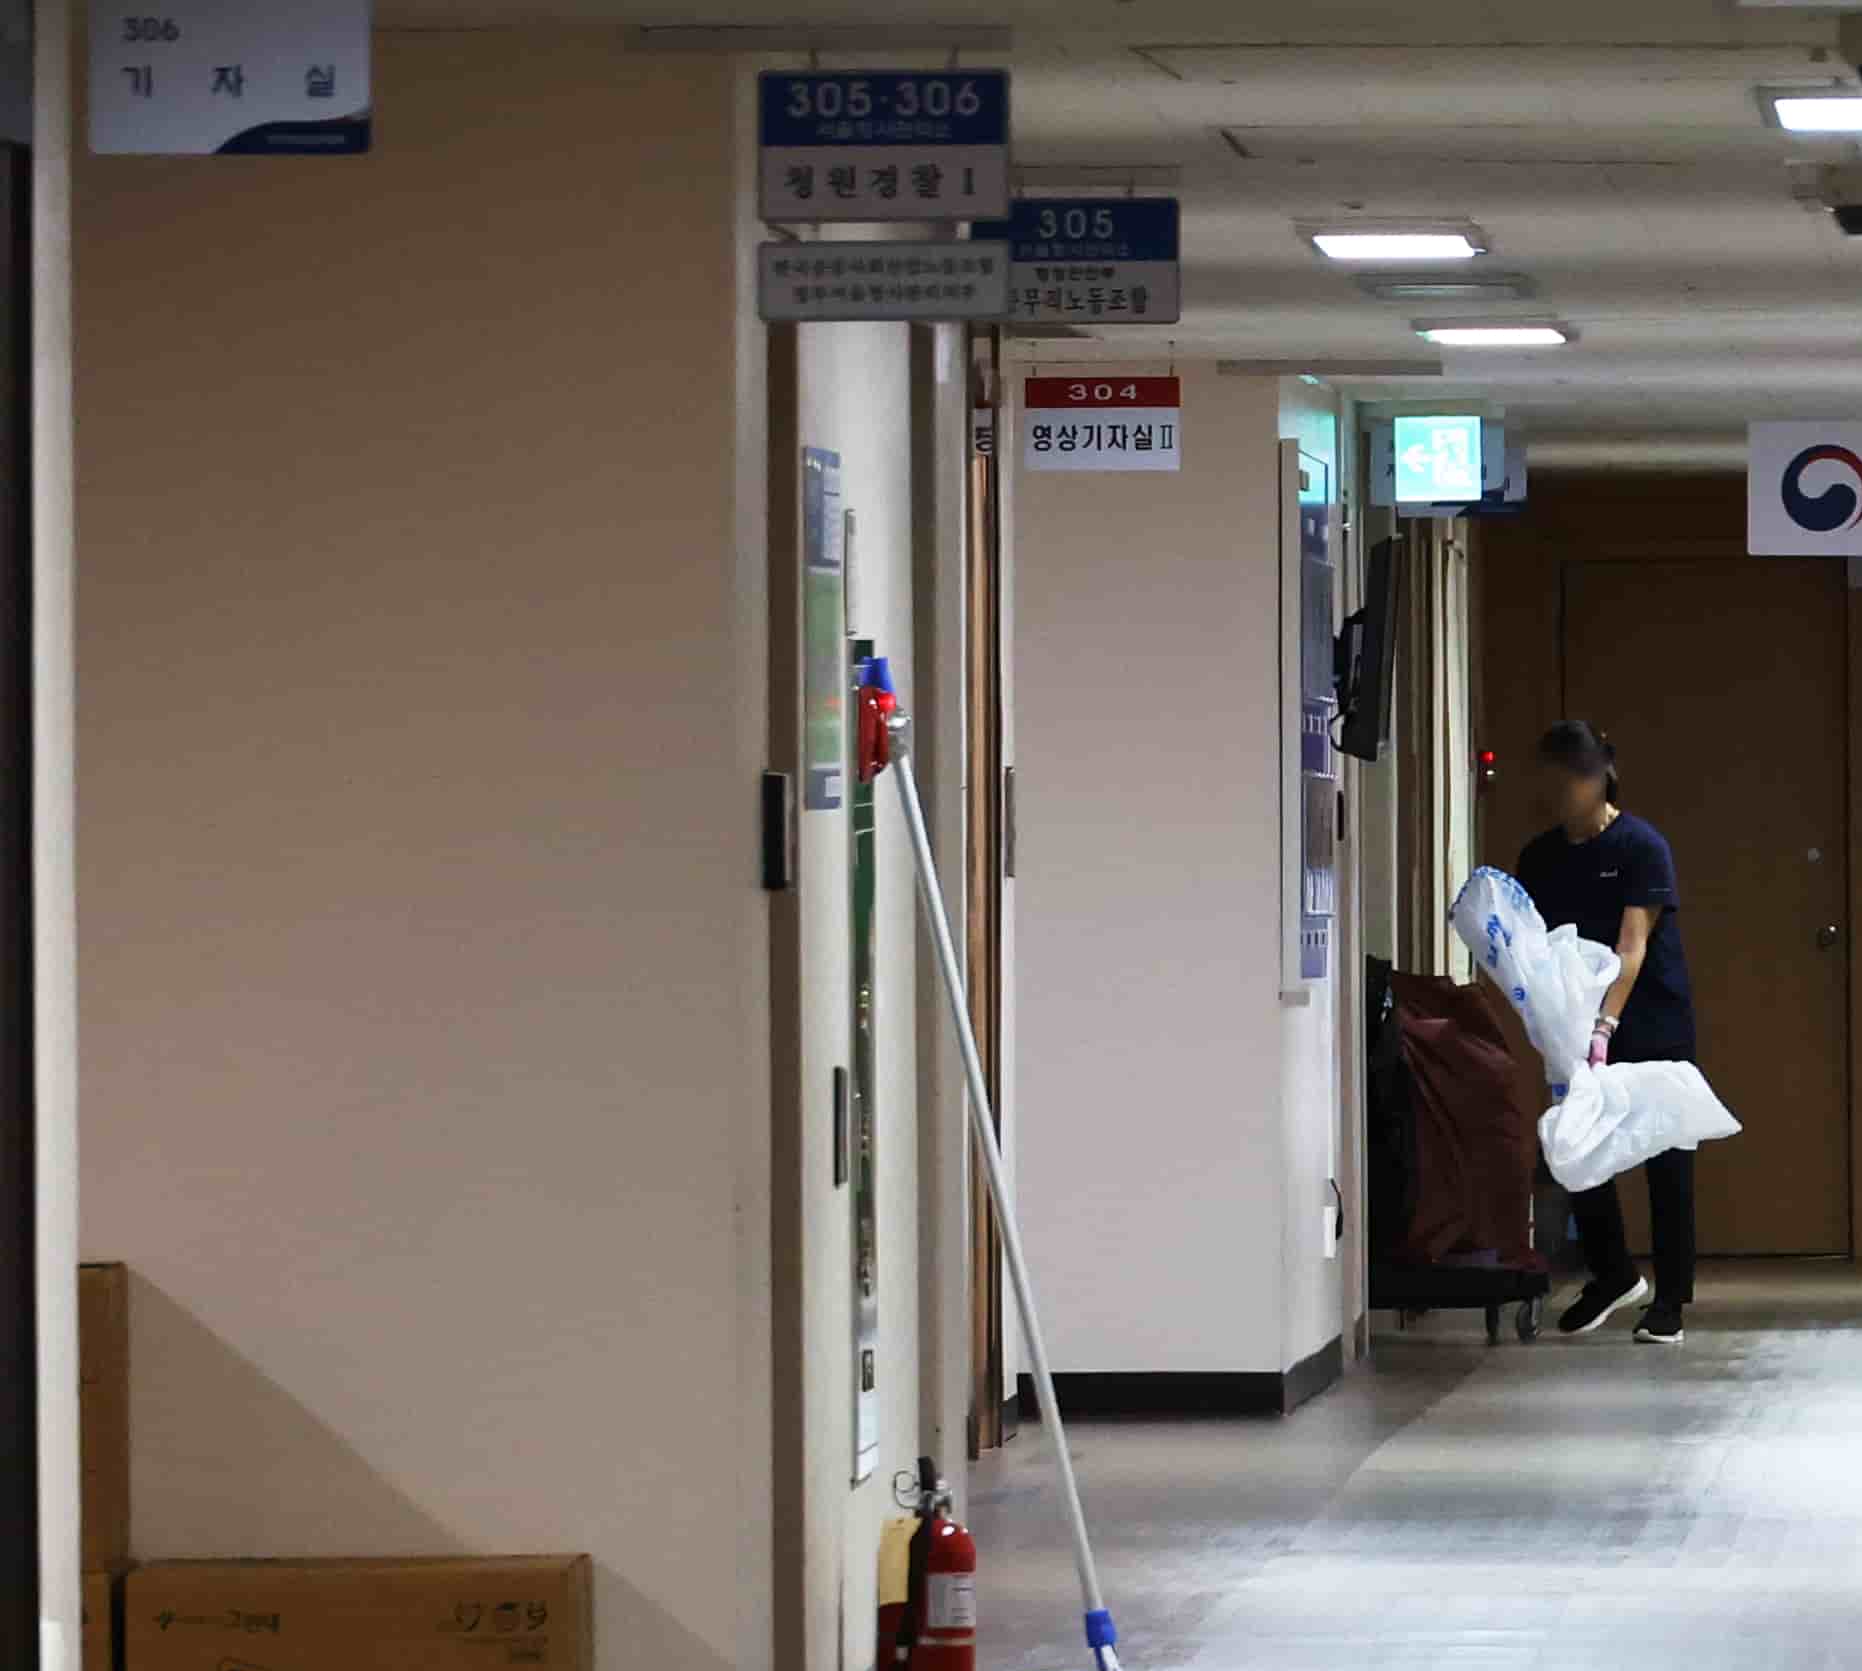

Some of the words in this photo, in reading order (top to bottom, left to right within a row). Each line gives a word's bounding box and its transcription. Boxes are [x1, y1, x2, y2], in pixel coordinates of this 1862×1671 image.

[121, 17, 180, 42] 306
[1039, 209, 1113, 239] 305
[1067, 384, 1137, 401] 304
